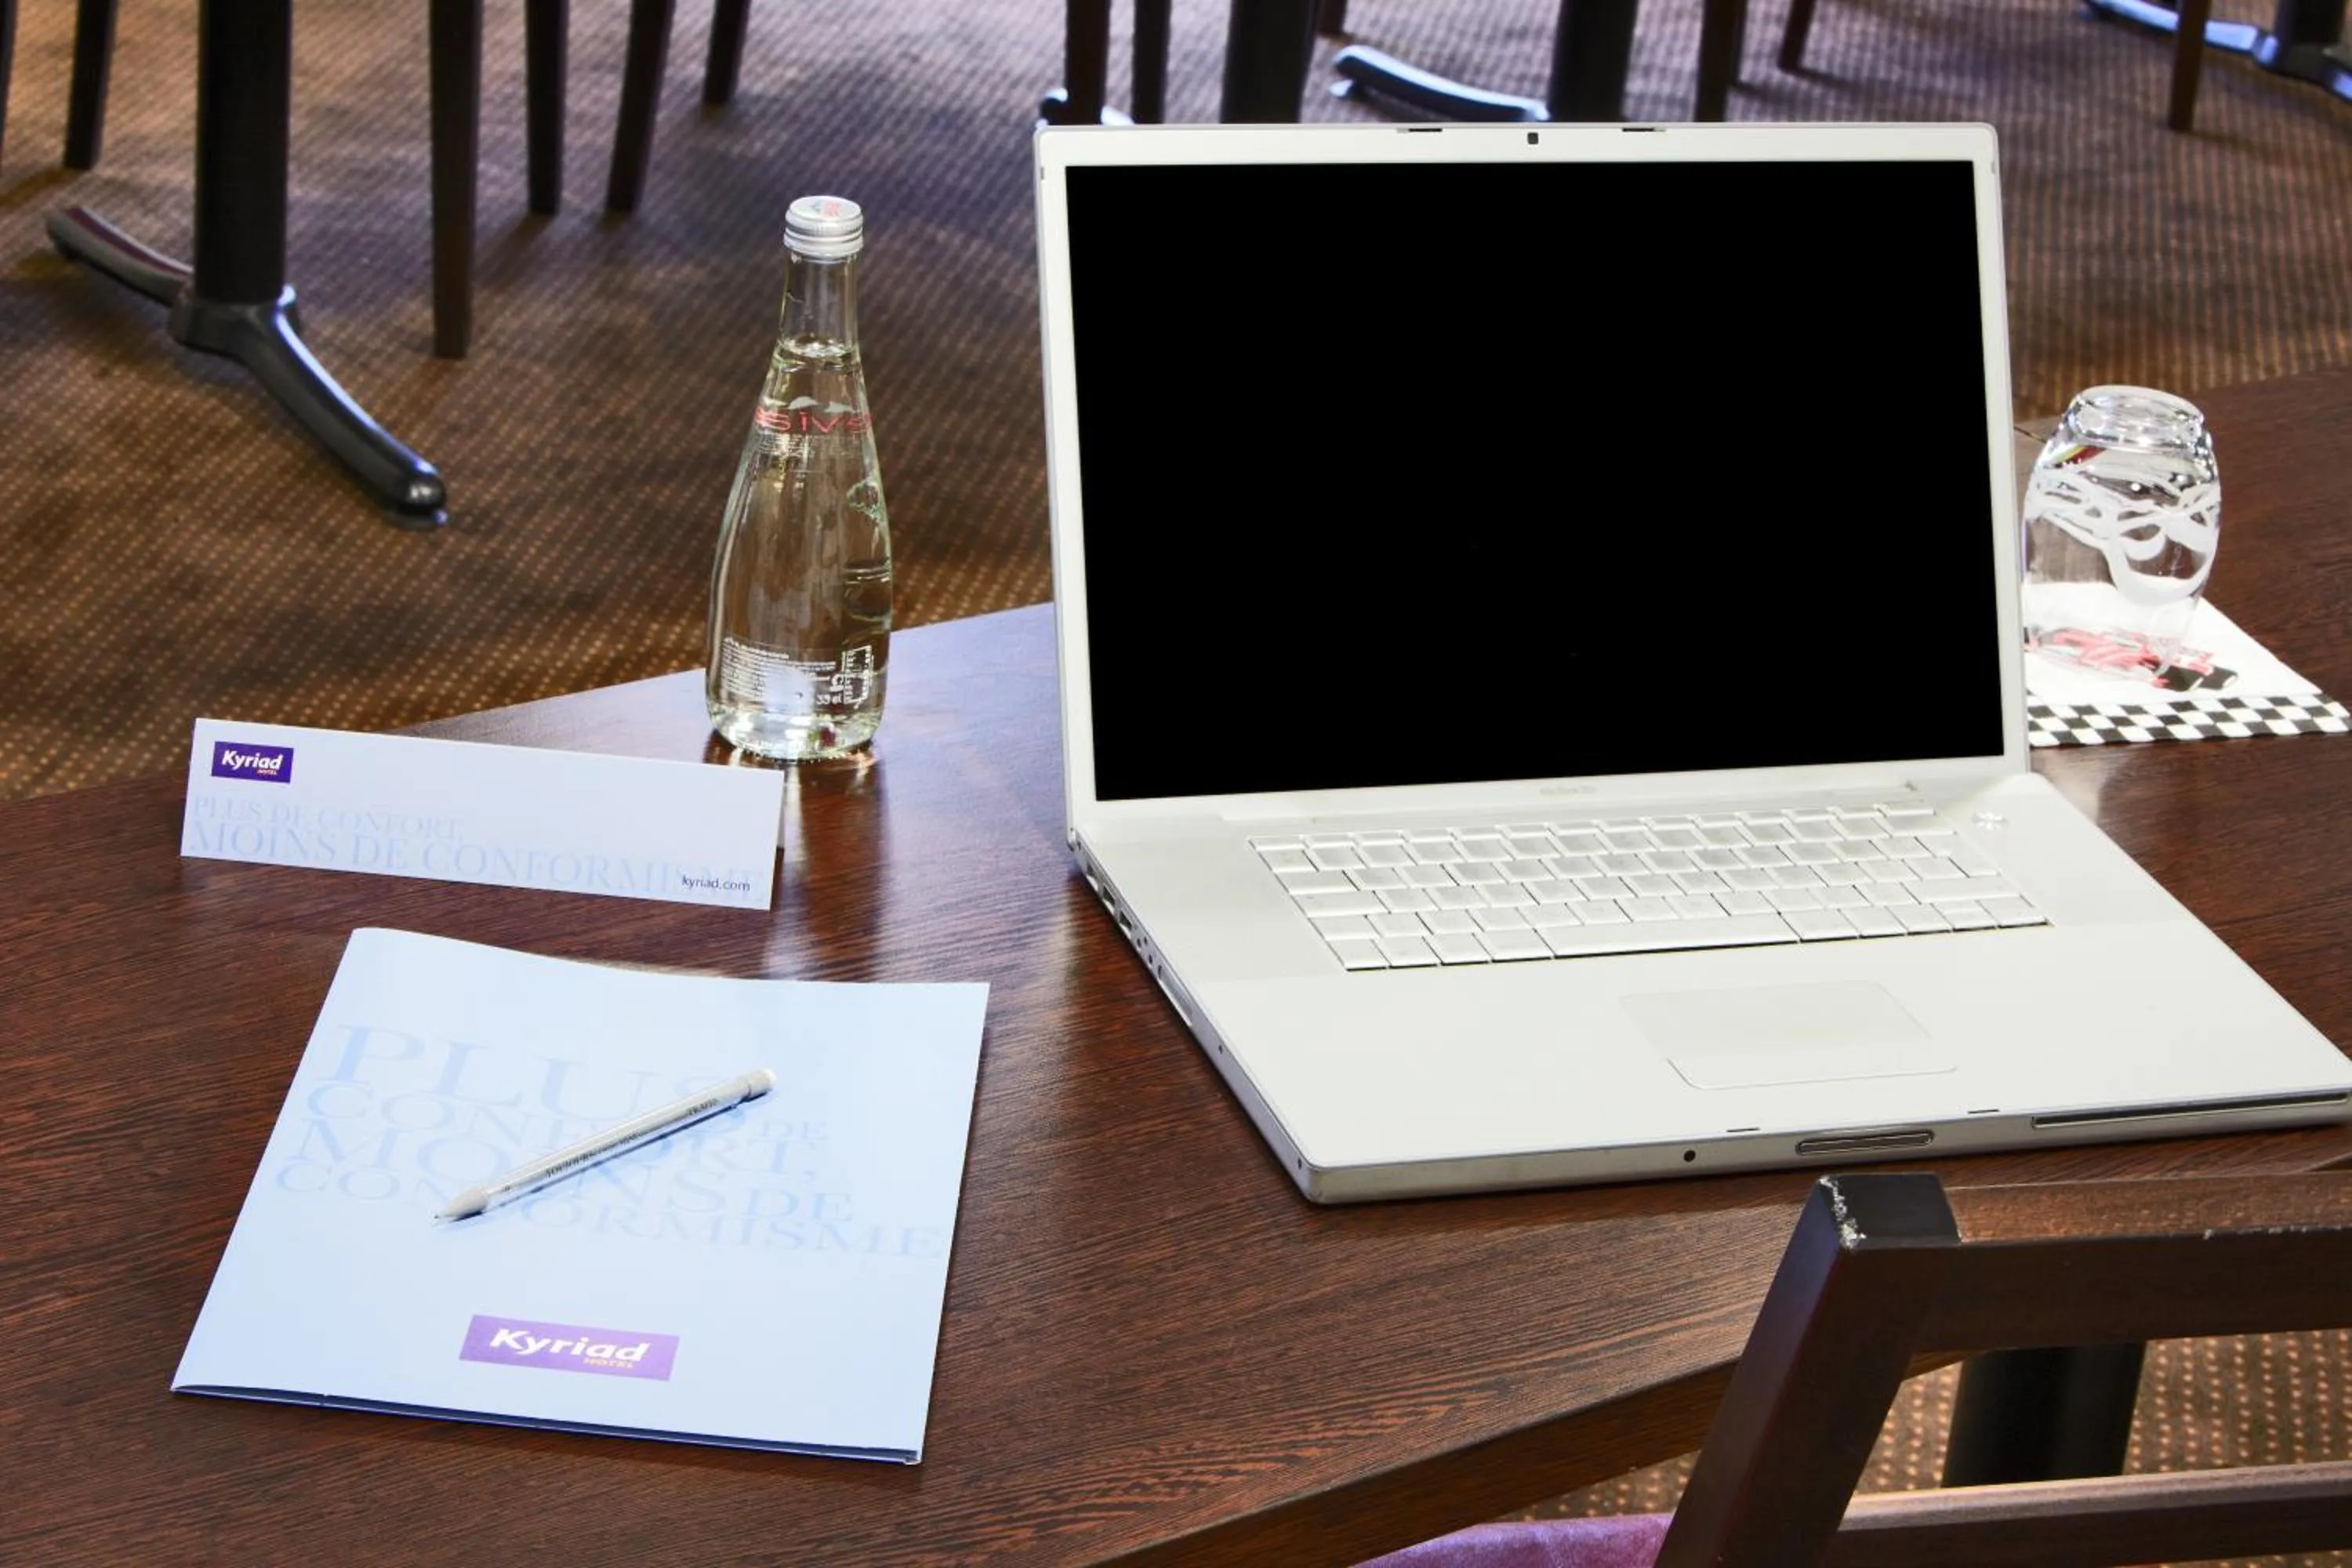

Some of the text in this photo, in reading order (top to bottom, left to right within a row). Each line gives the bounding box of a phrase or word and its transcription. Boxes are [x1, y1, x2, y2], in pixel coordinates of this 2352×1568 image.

[221, 750, 283, 770] Kyriad
[193, 795, 263, 820] PLUS
[270, 803, 307, 826] DE
[190, 819, 337, 862] MOINS
[350, 833, 409, 869] DE
[681, 874, 750, 891] kyriad.com
[307, 1083, 816, 1185] CONFRT,
[757, 1119, 829, 1140] DE
[285, 1118, 724, 1212] MONS
[738, 1188, 851, 1221] DE
[276, 1160, 946, 1261] CONORMISME
[489, 1328, 651, 1362] Kyriad
[583, 1357, 633, 1369] HOTEL
